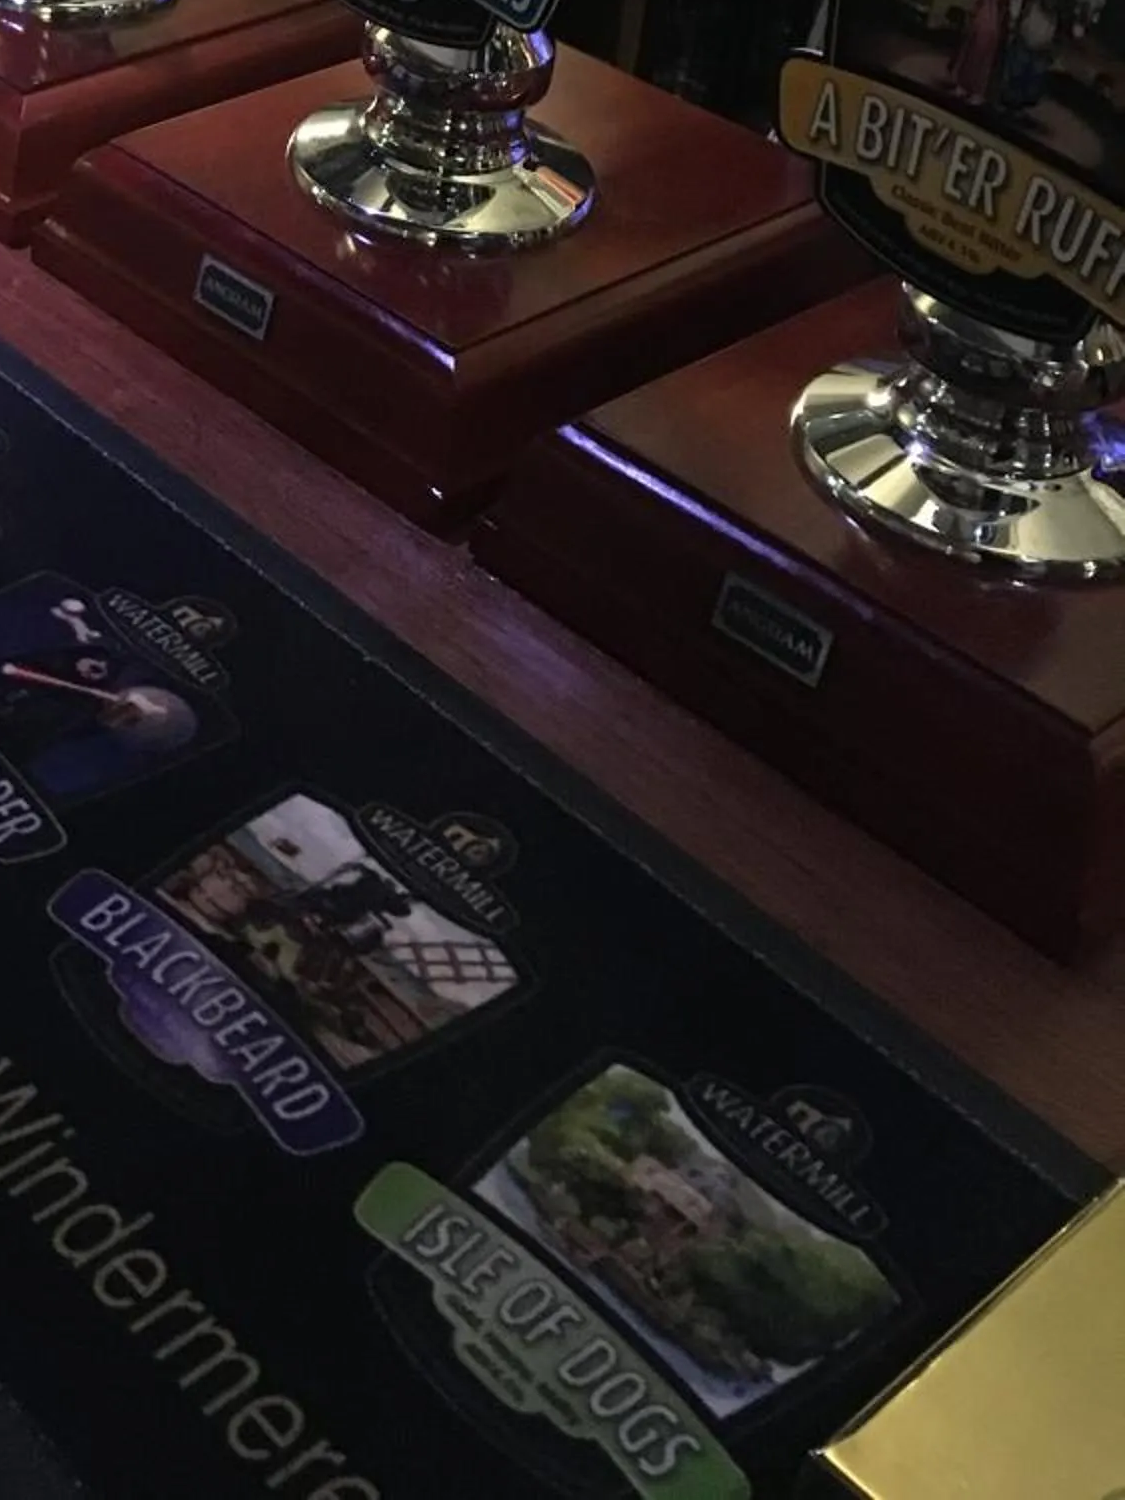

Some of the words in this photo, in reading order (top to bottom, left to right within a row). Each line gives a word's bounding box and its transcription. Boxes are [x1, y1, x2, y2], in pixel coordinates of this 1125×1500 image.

[809, 80, 838, 147] A
[108, 593, 219, 684] WATERMILL
[369, 808, 506, 924] WATERMILL
[79, 891, 331, 1122] BLACKBEARD
[702, 1082, 872, 1225] WATERMILL
[403, 1203, 516, 1294] ISLE
[498, 1279, 583, 1343] OF
[558, 1338, 701, 1477] DOGS
